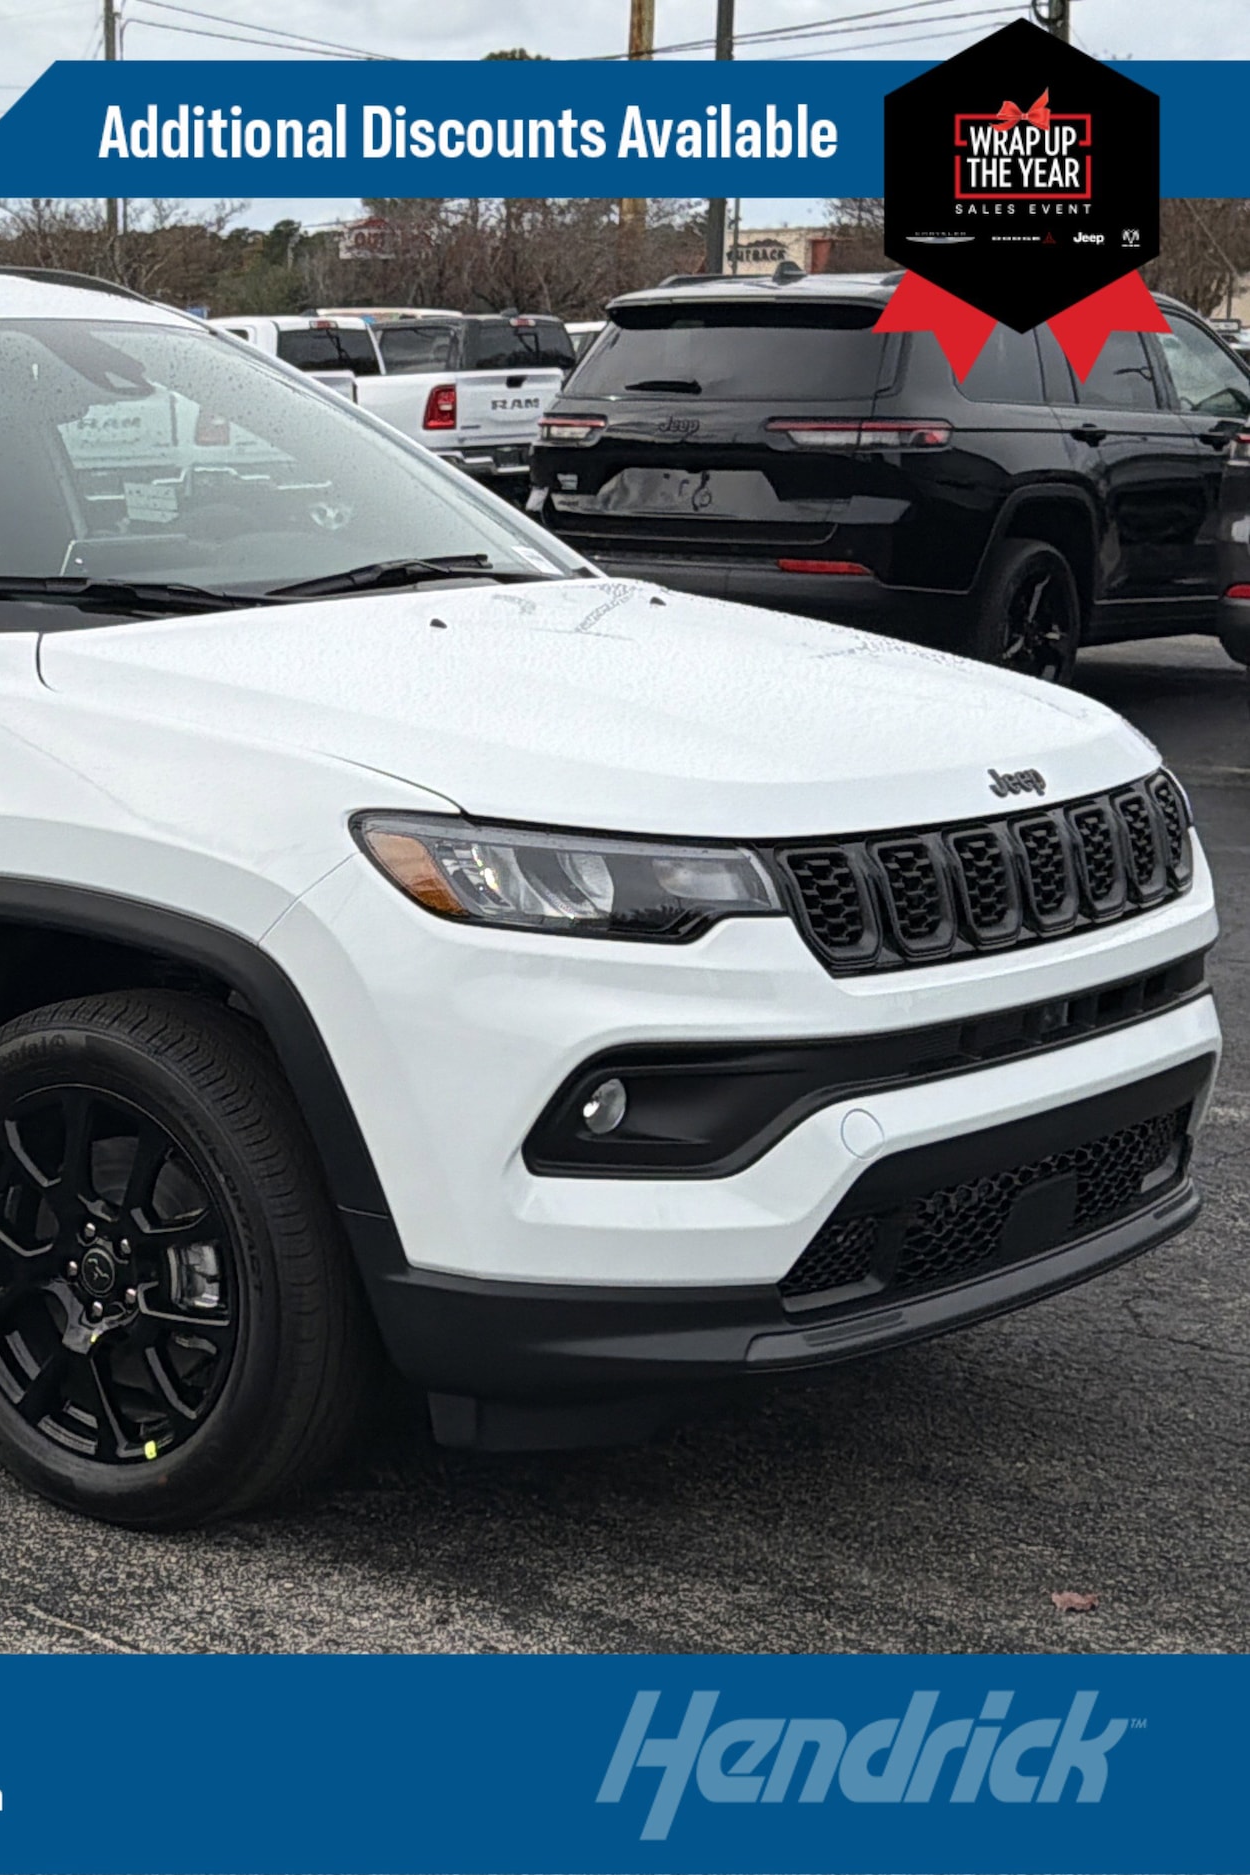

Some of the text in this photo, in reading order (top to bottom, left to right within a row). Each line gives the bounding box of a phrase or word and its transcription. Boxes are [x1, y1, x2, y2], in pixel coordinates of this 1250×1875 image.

[491, 398, 540, 410] RAM
[658, 416, 700, 434] Jeep
[987, 768, 1047, 798] Jeep
